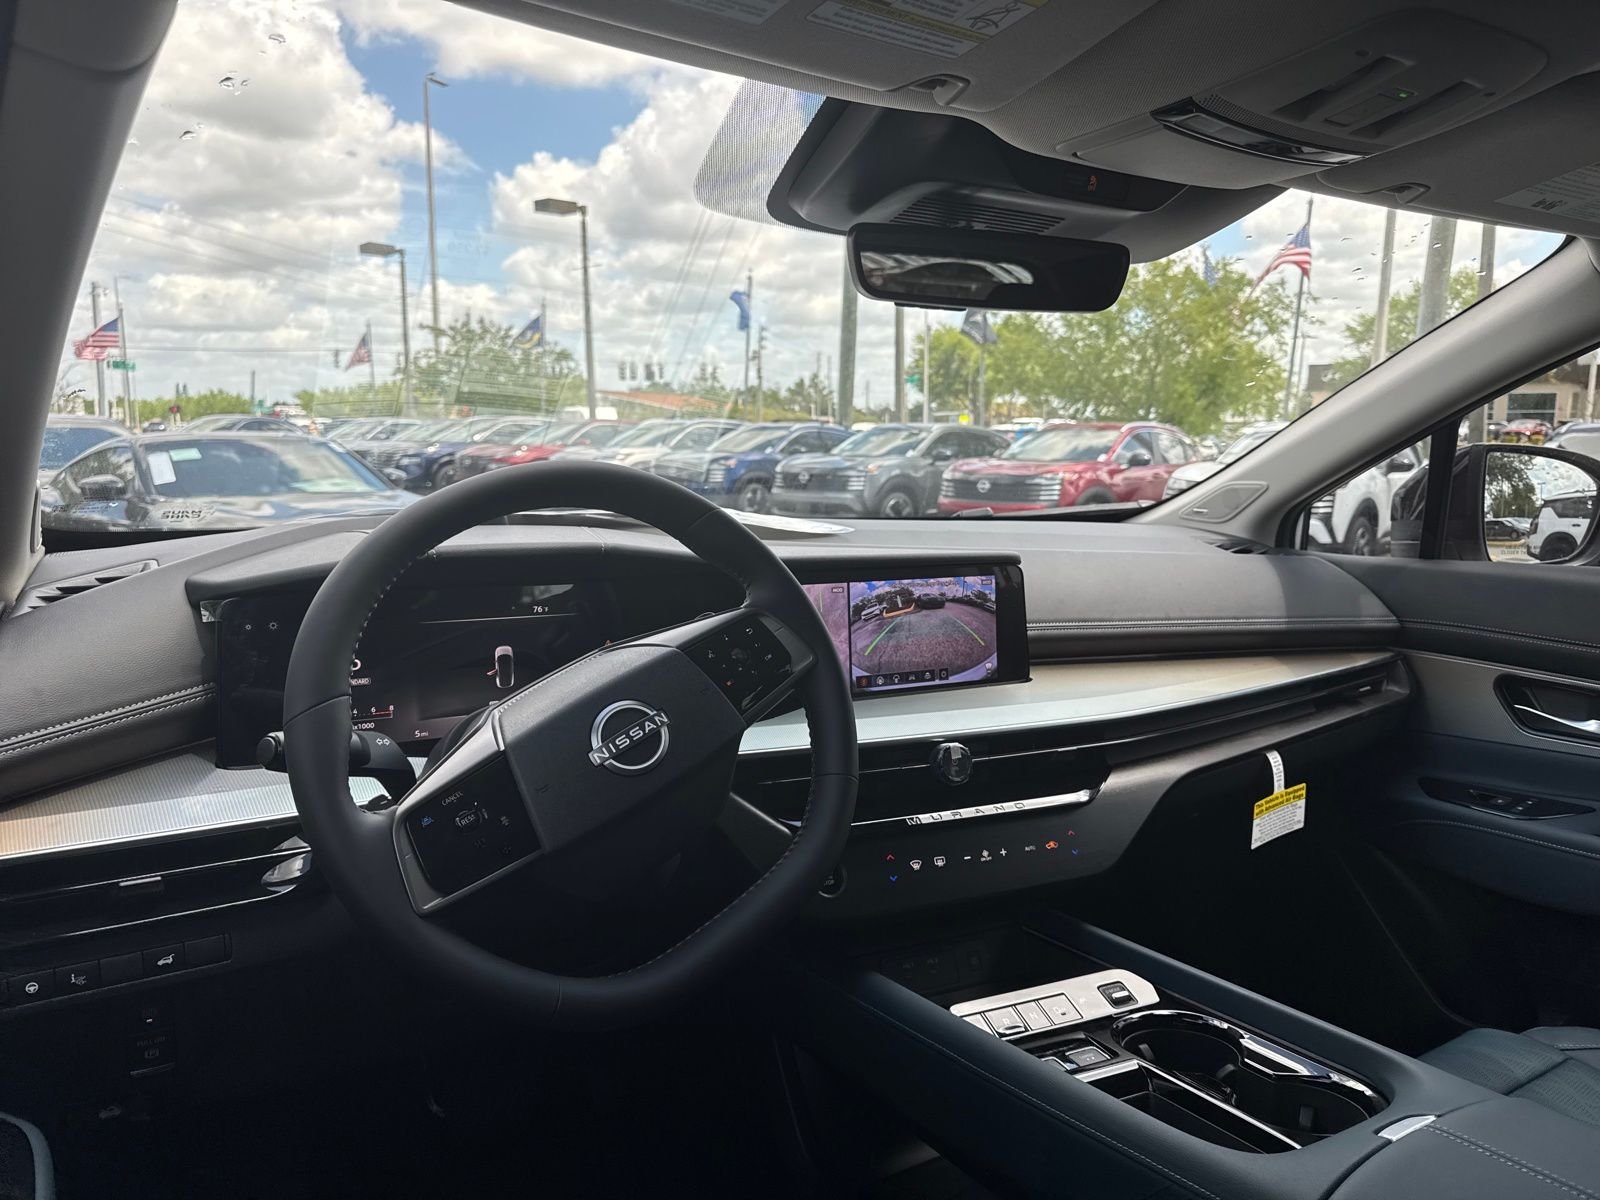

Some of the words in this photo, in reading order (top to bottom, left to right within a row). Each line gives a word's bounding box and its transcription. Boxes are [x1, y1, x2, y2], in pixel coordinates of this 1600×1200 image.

[532, 605, 543, 613] 76
[351, 677, 370, 686] NDARD
[592, 712, 668, 764] NISSAN
[441, 791, 463, 806] CANCEL
[906, 802, 1026, 826] MURANO
